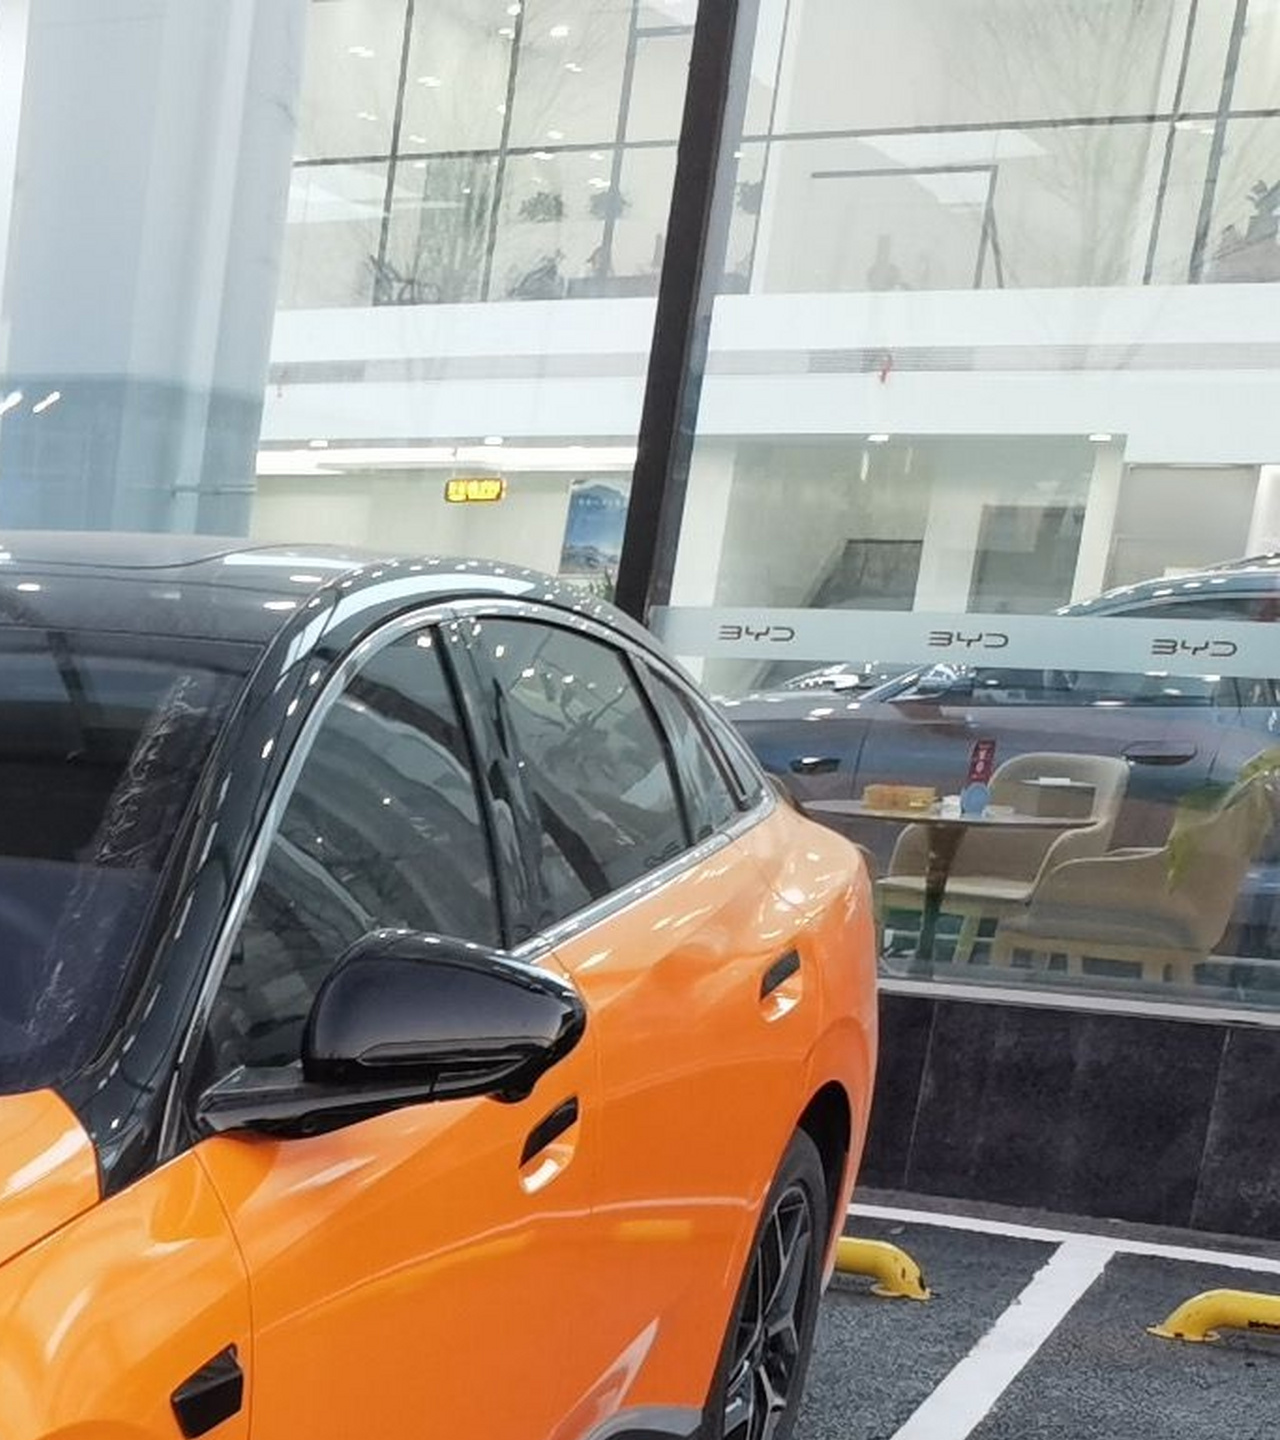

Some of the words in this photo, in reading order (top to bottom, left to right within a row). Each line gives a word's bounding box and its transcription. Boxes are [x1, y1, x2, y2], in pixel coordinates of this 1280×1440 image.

[718, 625, 795, 643] BYD
[928, 630, 1009, 649] BYD
[1151, 638, 1238, 658] BYD
